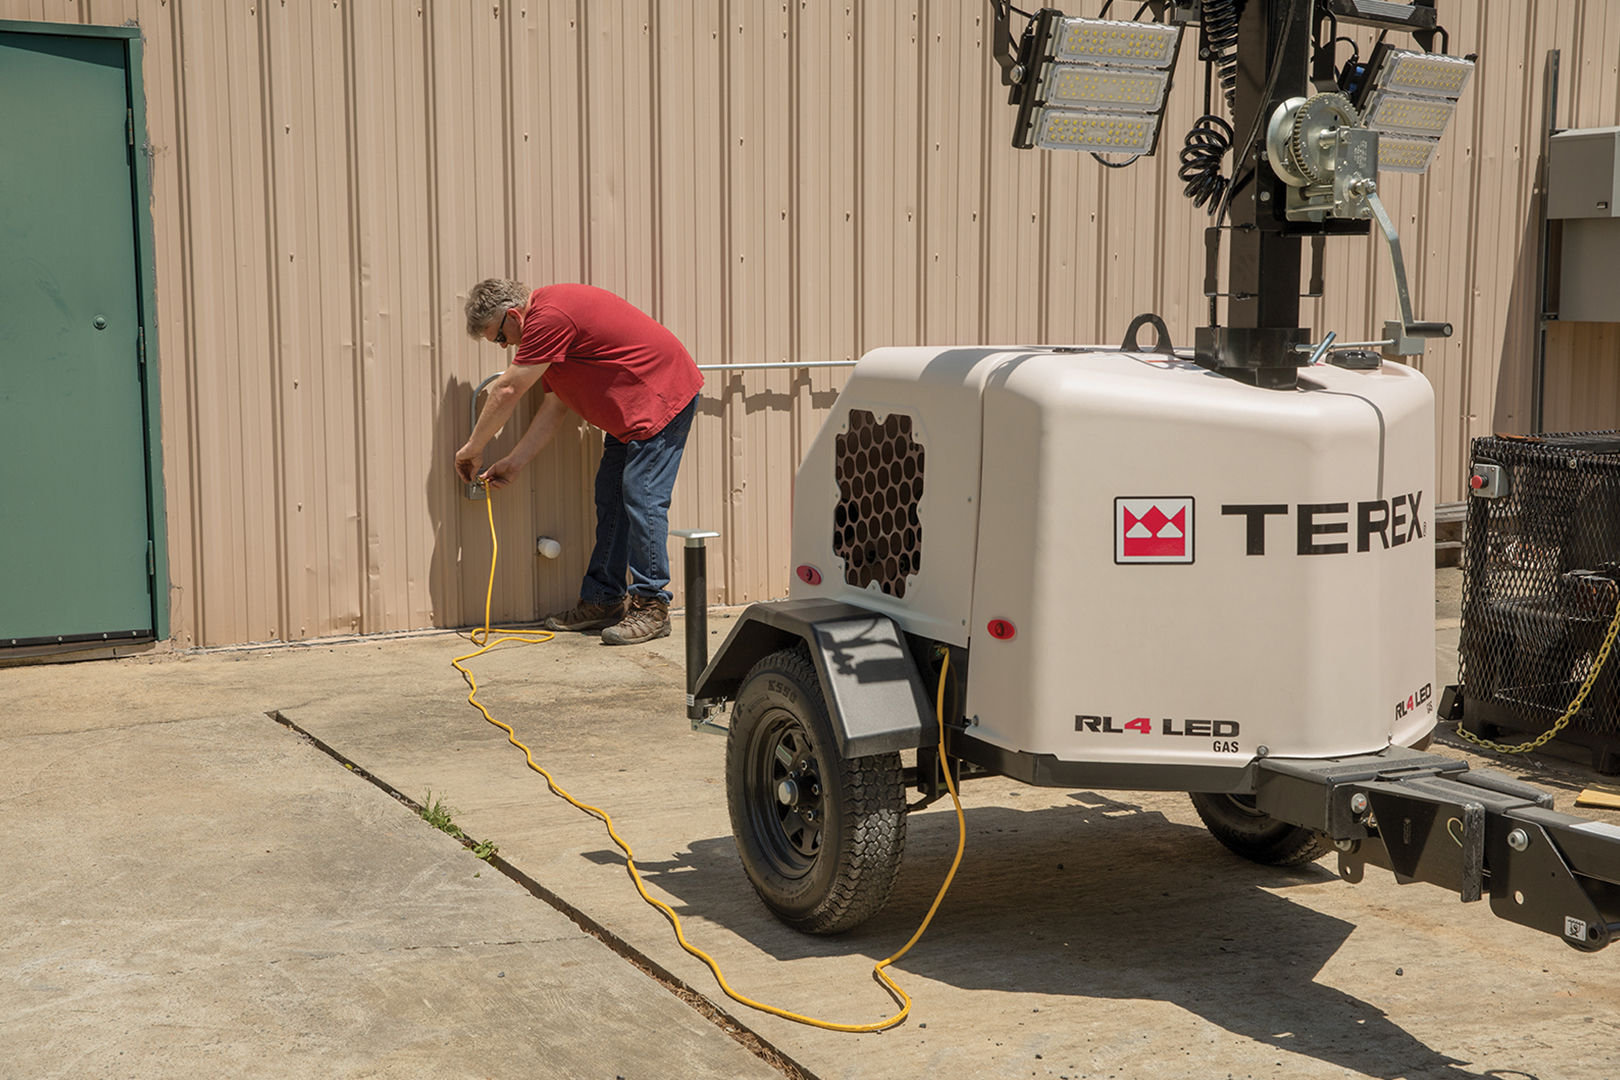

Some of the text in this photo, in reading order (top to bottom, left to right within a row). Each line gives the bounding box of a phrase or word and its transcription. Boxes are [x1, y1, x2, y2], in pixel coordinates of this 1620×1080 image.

[1221, 490, 1423, 556] TEREX
[1395, 682, 1432, 721] RL4 LED
[1074, 715, 1240, 738] RL4 LED
[1213, 741, 1239, 753] GAS
